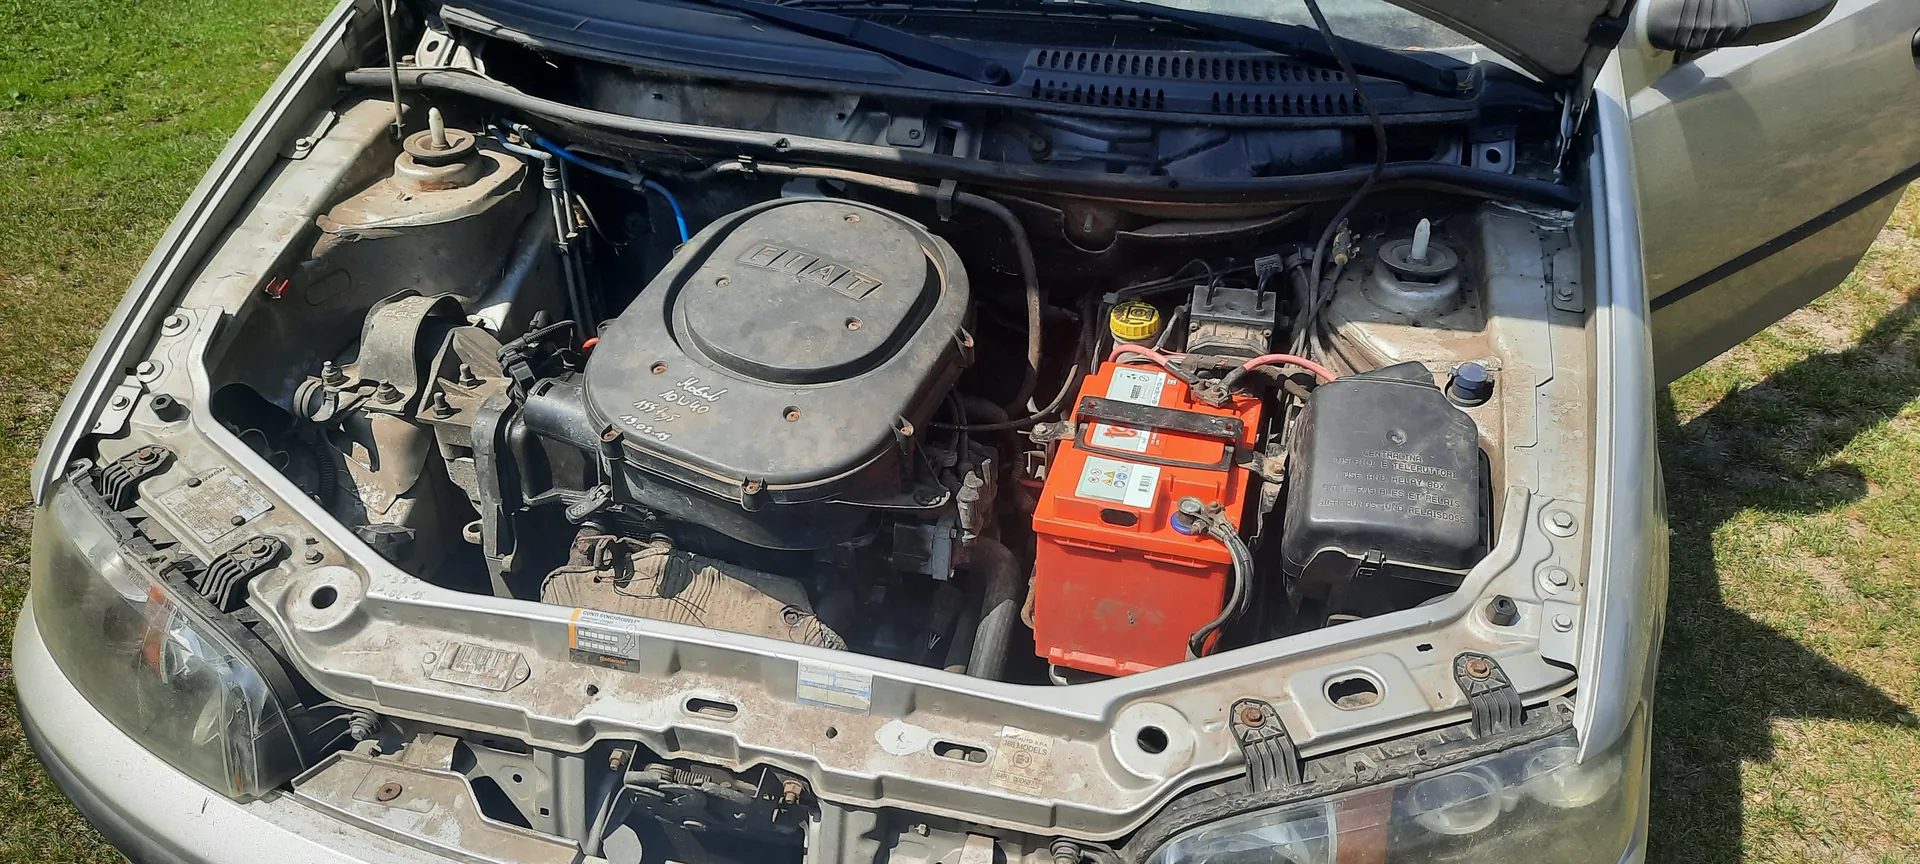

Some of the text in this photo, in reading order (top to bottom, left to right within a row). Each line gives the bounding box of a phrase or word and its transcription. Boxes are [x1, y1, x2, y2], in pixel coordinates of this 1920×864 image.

[748, 245, 874, 292] FIAT
[1362, 449, 1423, 464] CENTRALINA
[1392, 462, 1458, 479] TELERUTTORI
[1392, 475, 1423, 488] RELAY
[1427, 480, 1446, 491] BOX
[1407, 491, 1422, 501] ET
[1425, 494, 1462, 508] RELAIS
[1407, 506, 1467, 524] RELAISDOSE
[1016, 743, 1048, 756] MODELS
